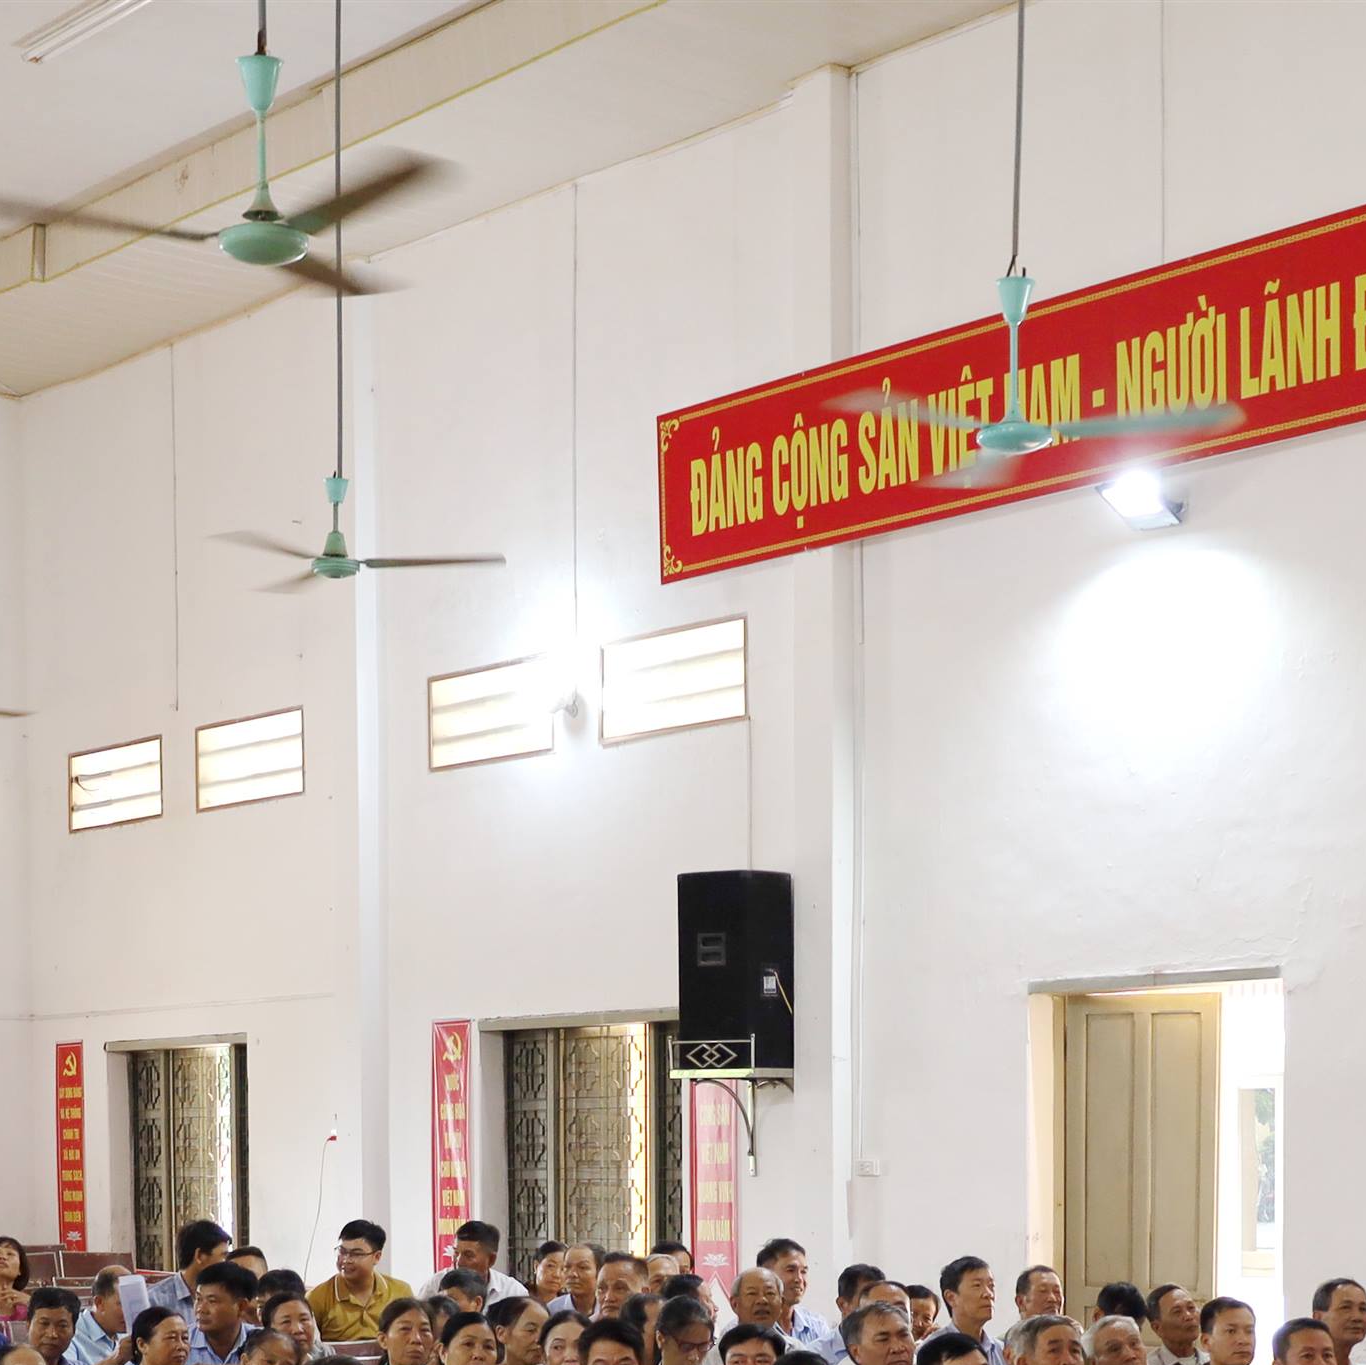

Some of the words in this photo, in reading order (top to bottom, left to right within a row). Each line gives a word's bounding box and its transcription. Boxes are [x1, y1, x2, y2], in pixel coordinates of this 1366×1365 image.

[690, 426, 763, 536] ĐẢNG
[772, 413, 849, 529] CỘNG
[858, 377, 919, 494] SẢN
[1092, 389, 1105, 408] -
[1116, 295, 1227, 424] NGƯỜI
[1240, 279, 1340, 399] LÃNH
